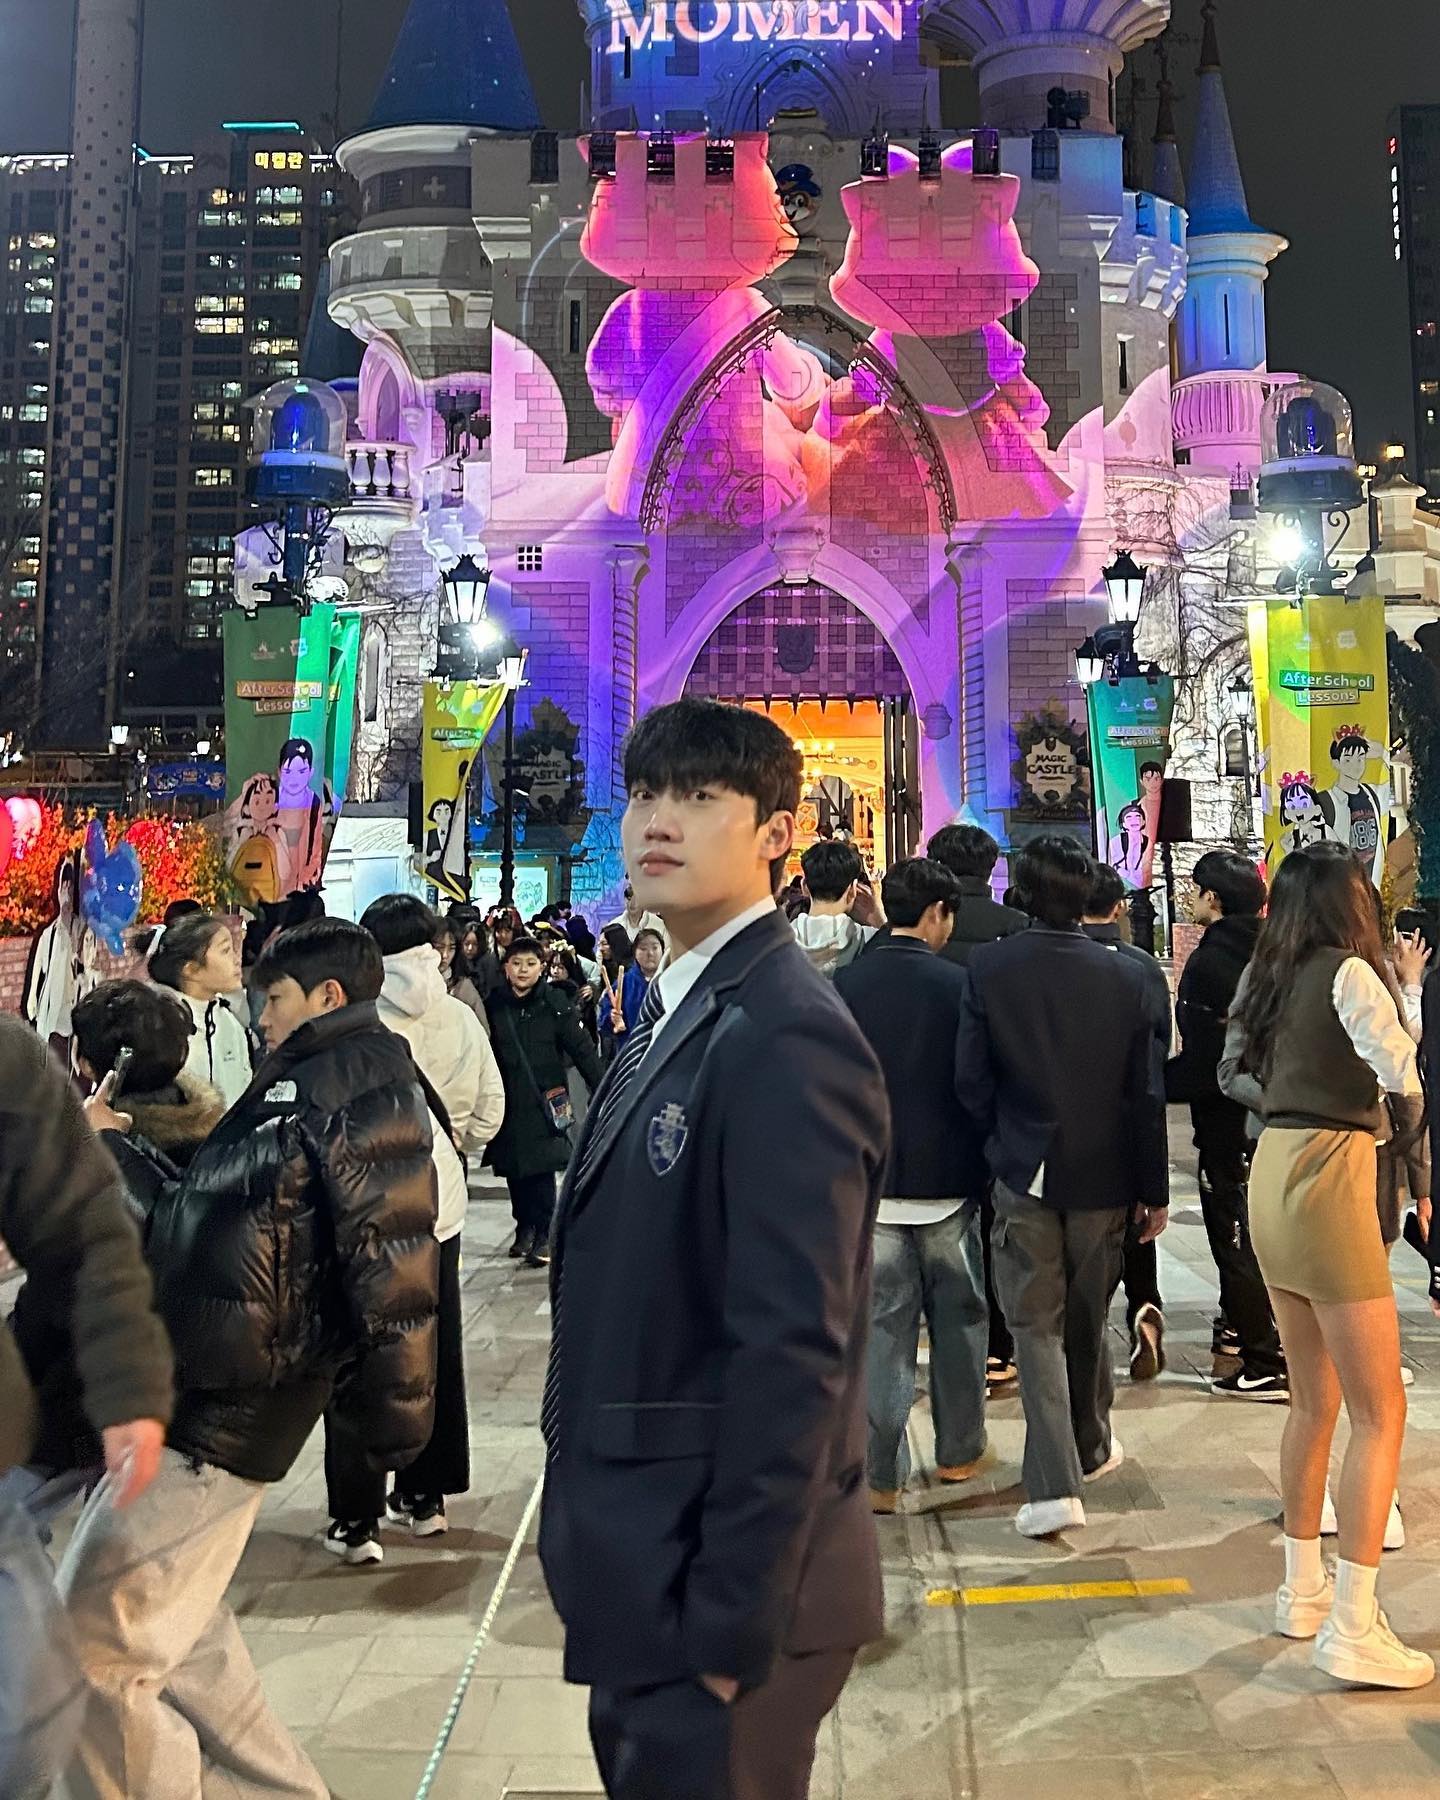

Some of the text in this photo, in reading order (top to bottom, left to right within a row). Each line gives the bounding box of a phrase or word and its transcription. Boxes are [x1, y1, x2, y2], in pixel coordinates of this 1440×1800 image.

[605, 0, 913, 53] MOMEN
[1283, 672, 1370, 687] After School
[241, 682, 321, 696] After School
[1298, 690, 1355, 703] Lessons
[255, 700, 308, 713] Lessons
[1036, 754, 1068, 764] MAGIC
[1027, 764, 1077, 775] CASTLE
